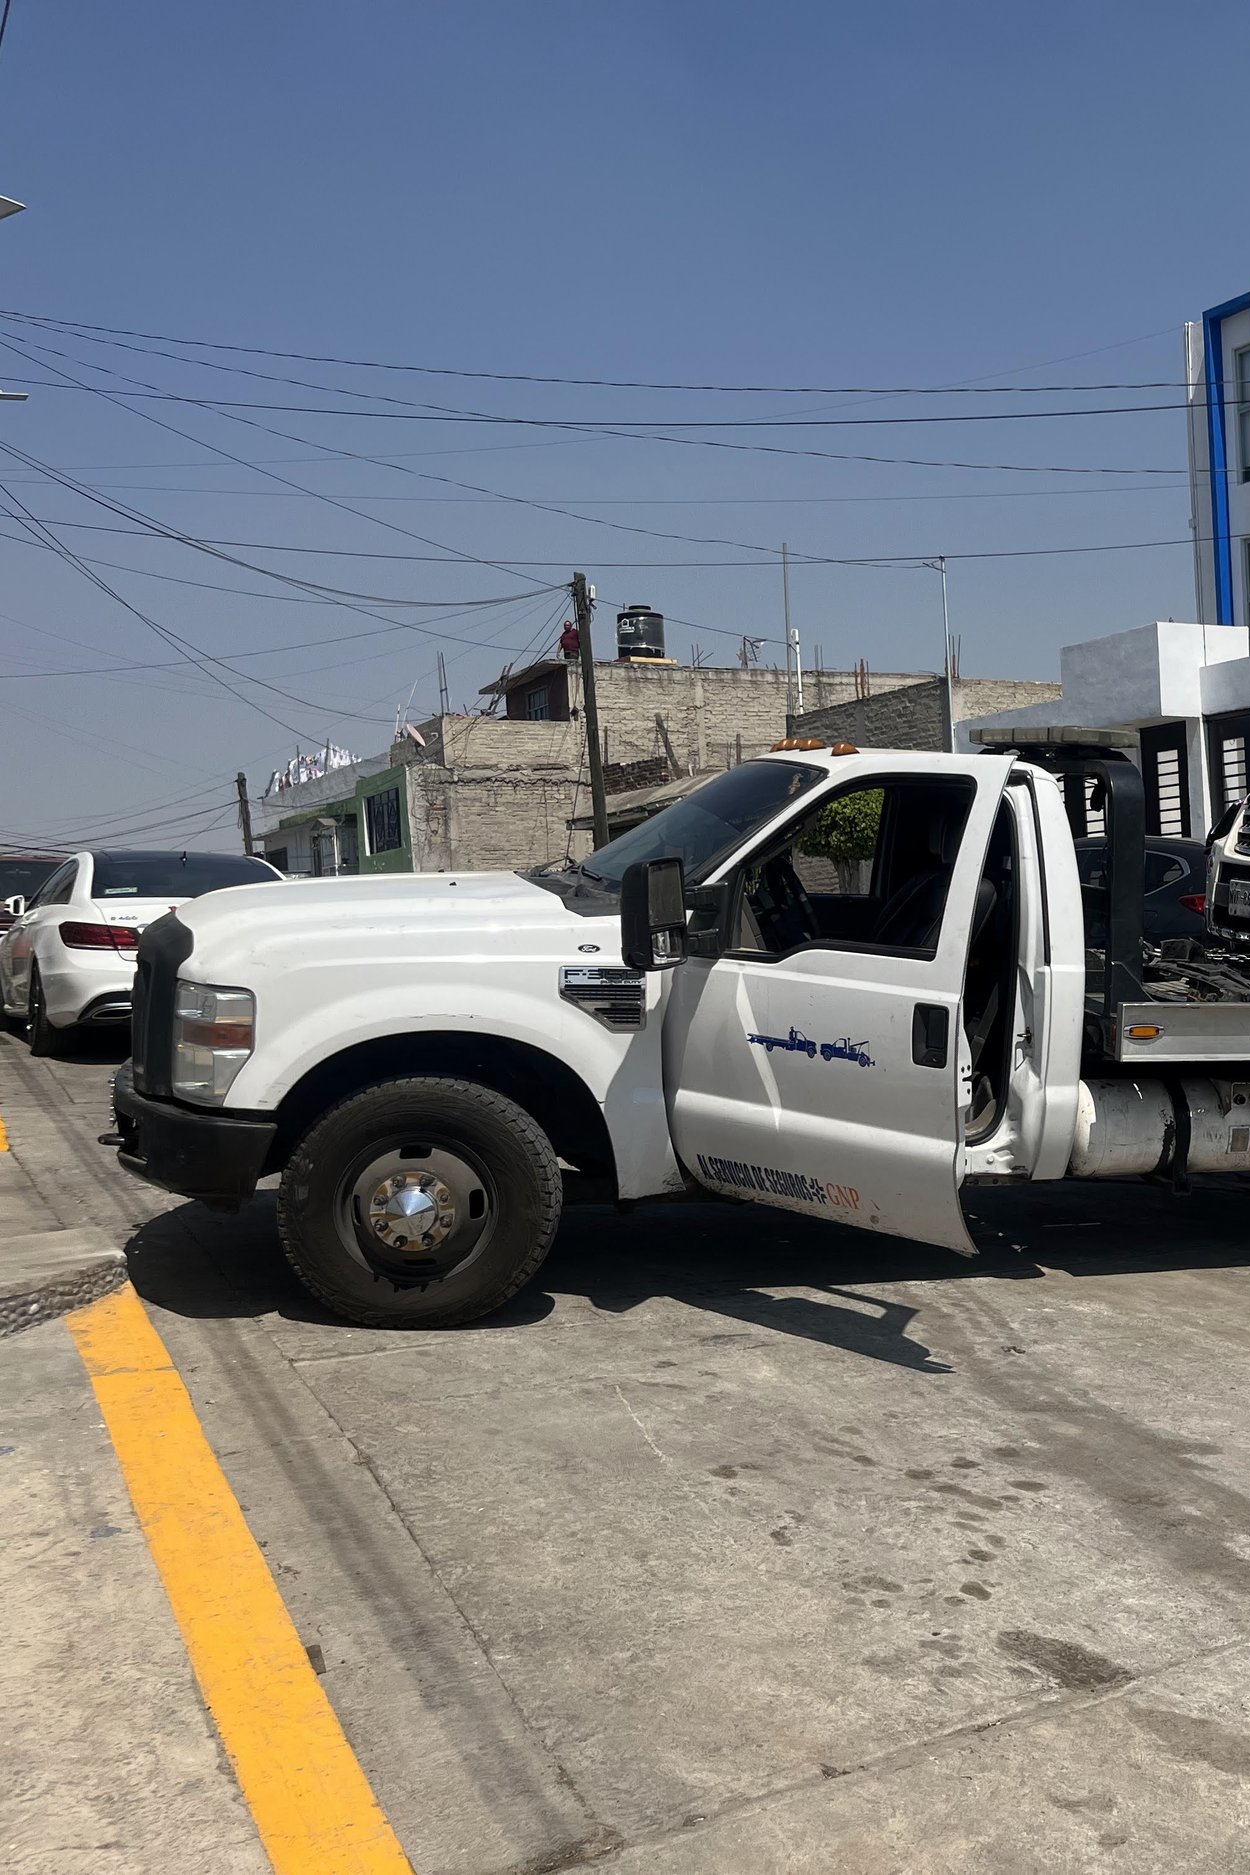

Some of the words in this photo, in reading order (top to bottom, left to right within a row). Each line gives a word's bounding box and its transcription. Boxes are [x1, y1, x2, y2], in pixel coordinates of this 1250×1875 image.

[708, 1155, 756, 1190] SERVICIO
[750, 1164, 770, 1192] DE
[764, 1167, 814, 1203] SEGUROS
[826, 1182, 860, 1210] GNP
